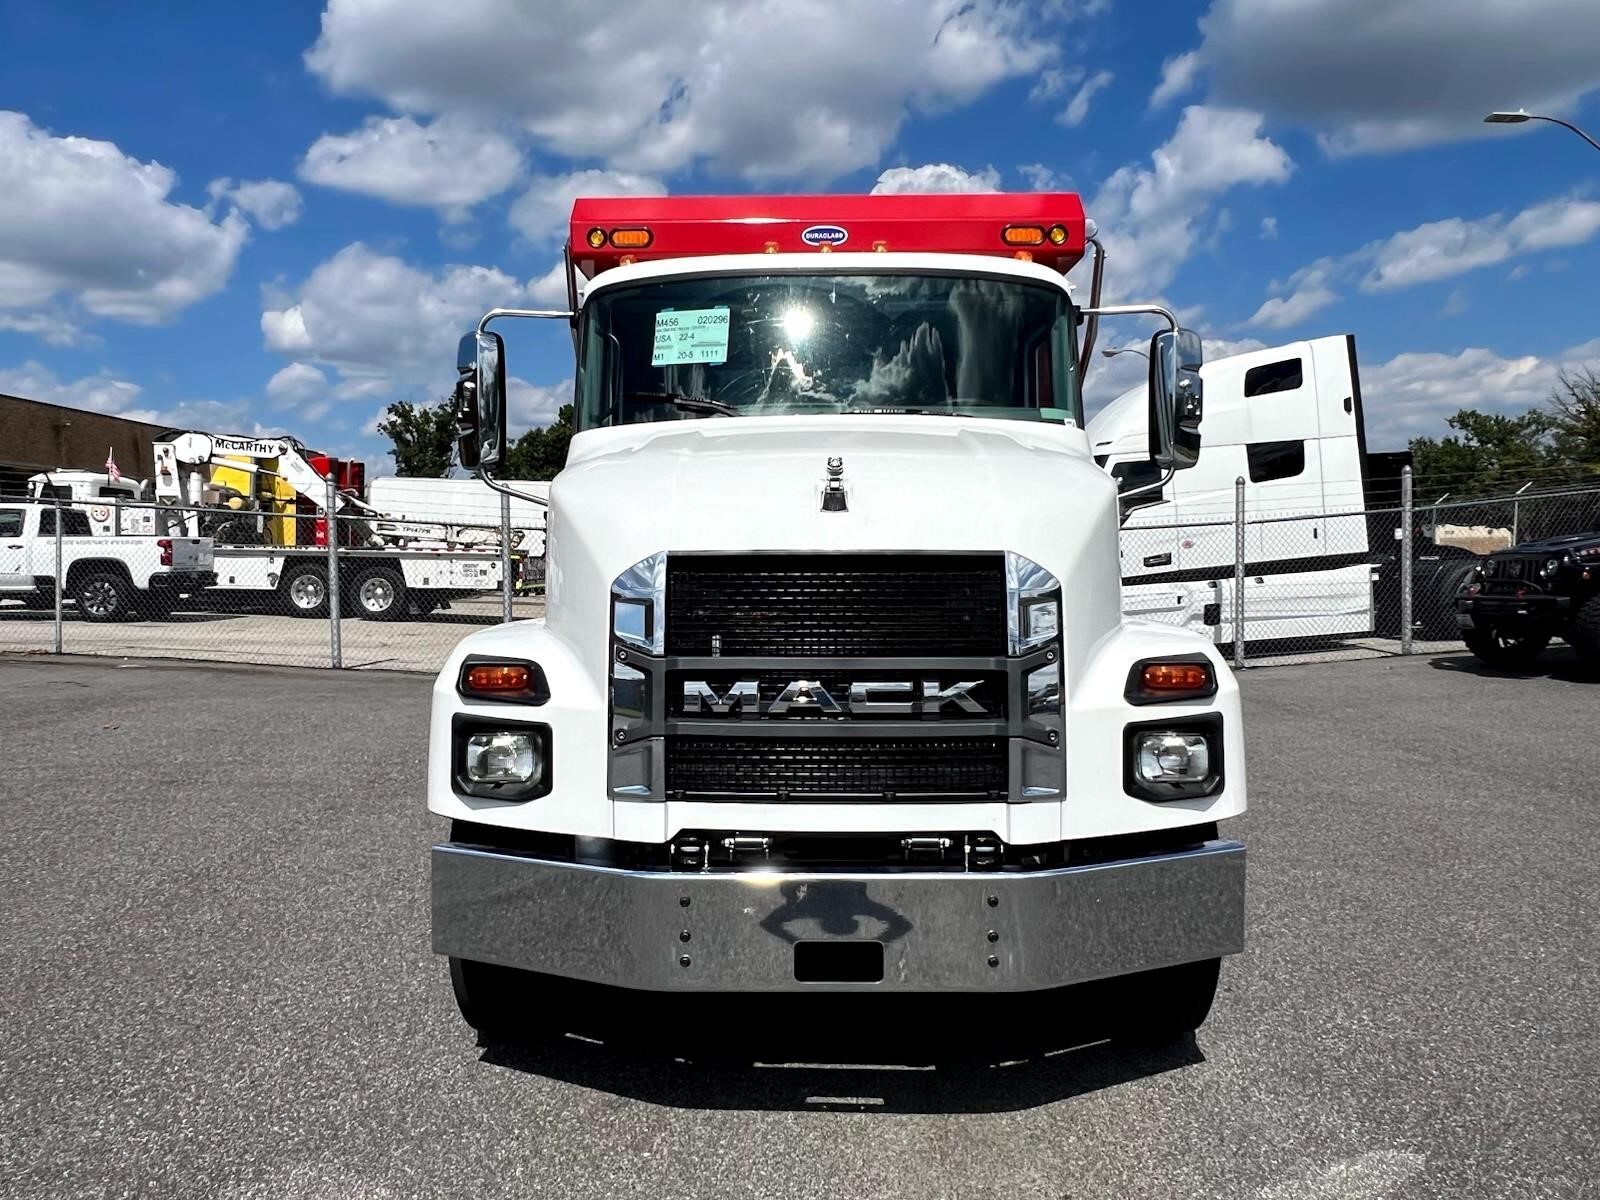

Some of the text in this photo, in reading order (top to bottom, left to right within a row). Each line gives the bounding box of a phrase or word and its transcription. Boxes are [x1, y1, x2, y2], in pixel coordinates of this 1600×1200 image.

[657, 315, 729, 327] M456 020296
[655, 333, 695, 343] USA 22-4
[701, 350, 718, 358] 1111
[215, 439, 275, 453] McCARTHY
[683, 680, 989, 712] MACK
